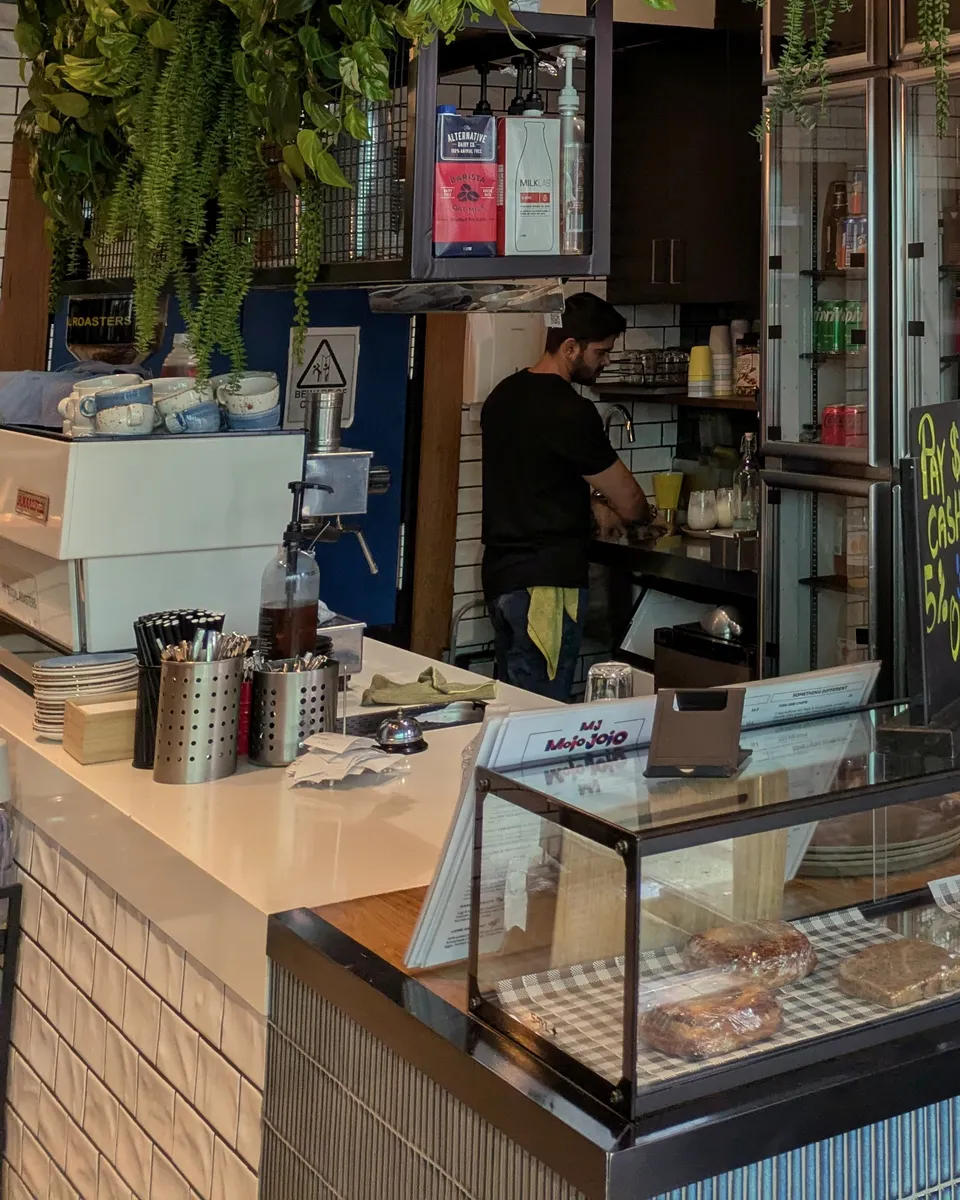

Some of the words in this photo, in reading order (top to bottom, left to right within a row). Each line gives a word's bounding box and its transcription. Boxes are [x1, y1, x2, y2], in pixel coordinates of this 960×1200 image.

[447, 131, 487, 144] ALTERNATIVE
[450, 174, 485, 183] BARISTA
[950, 421, 960, 482] $
[923, 558, 948, 633] 5%
[792, 690, 821, 698] SOMETHING
[821, 685, 848, 694] DIFFERENT
[579, 720, 603, 731] MJ
[544, 735, 586, 752] Mojo
